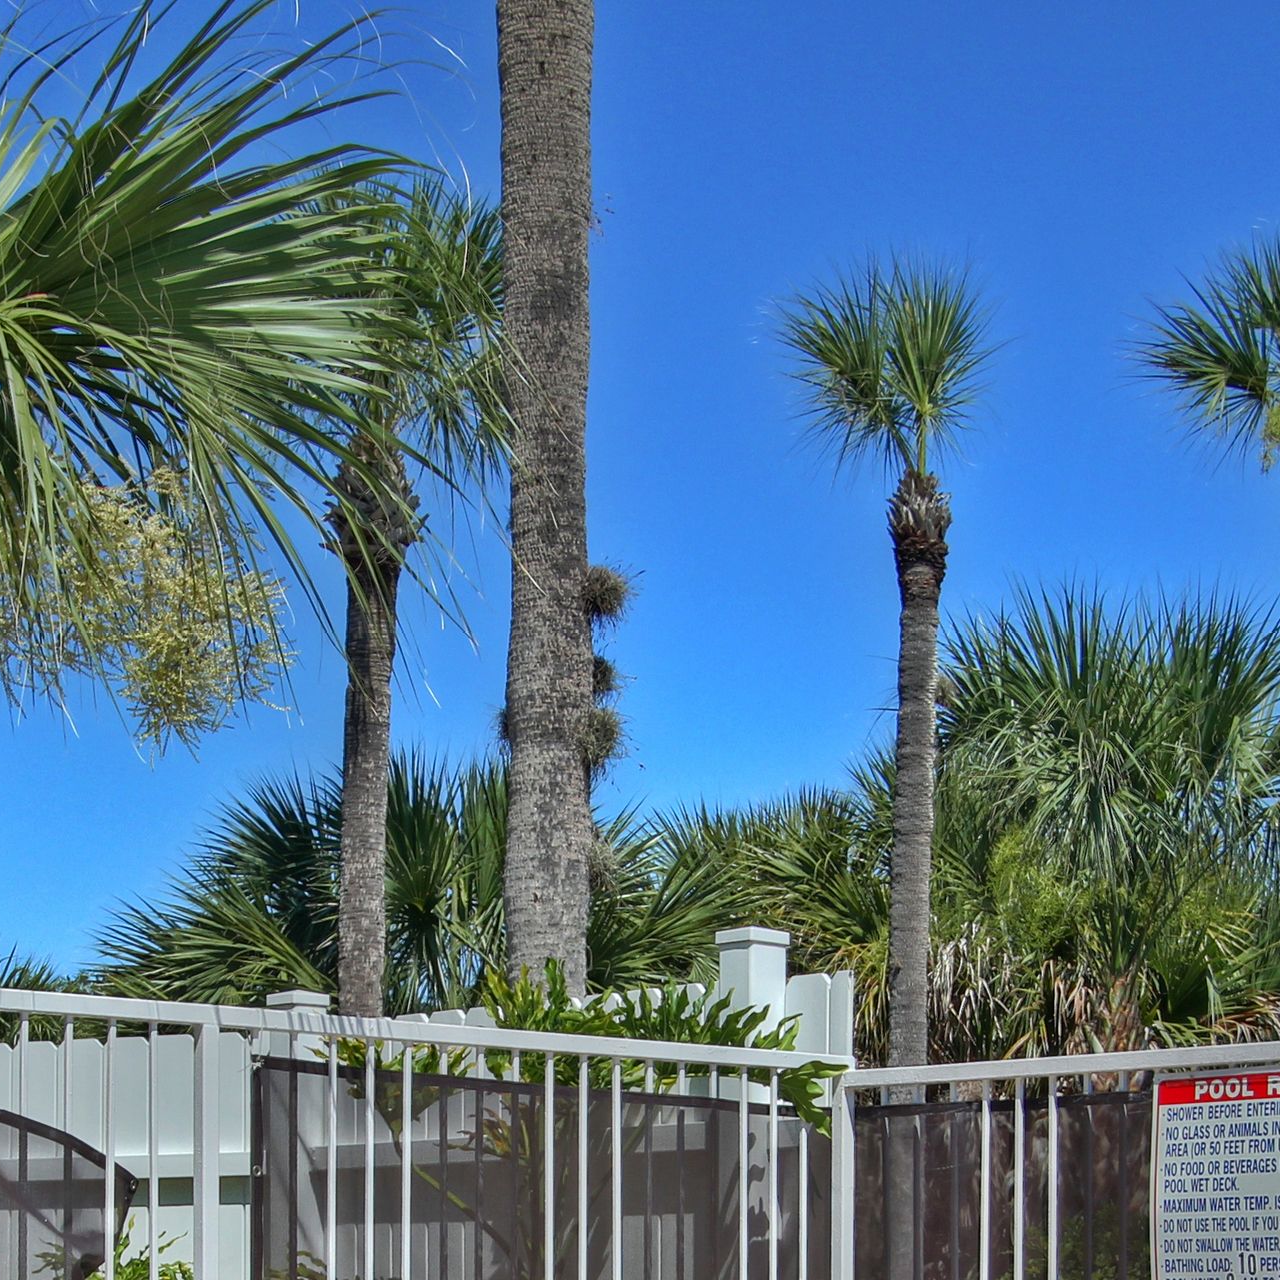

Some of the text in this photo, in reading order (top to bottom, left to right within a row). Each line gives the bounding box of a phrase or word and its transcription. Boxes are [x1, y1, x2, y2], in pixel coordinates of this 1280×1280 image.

[1194, 1078, 1254, 1100] POOL
[1167, 1107, 1203, 1122] SHOWER
[1209, 1103, 1242, 1119] BEFORE
[1166, 1127, 1179, 1140] NO
[1183, 1125, 1210, 1140] GLASS
[1213, 1123, 1224, 1138] OR
[1228, 1120, 1268, 1137] ANIMALS
[1272, 1121, 1280, 1135] IN
[1165, 1143, 1188, 1157] AREA
[1191, 1142, 1206, 1159] (OR
[1210, 1143, 1220, 1155] 50
[1223, 1140, 1245, 1155] FEET
[1249, 1138, 1275, 1153] FROM
[1164, 1162, 1177, 1177] NO
[1180, 1161, 1204, 1176] FOOD
[1208, 1161, 1220, 1175] OR
[1224, 1158, 1277, 1174] BEVERAGES
[1164, 1177, 1239, 1193] POOL WET DECK.
[1164, 1198, 1206, 1213] MAXIMUM
[1209, 1197, 1241, 1211] WATER
[1244, 1195, 1272, 1210] TEMP.
[1164, 1219, 1175, 1233] DO
[1177, 1219, 1193, 1233] NOT
[1194, 1218, 1209, 1232] USE
[1212, 1217, 1227, 1232] THE
[1229, 1216, 1250, 1231] POOL
[1252, 1216, 1259, 1231] IF
[1261, 1216, 1279, 1230] YOU
[1164, 1239, 1174, 1252] DO
[1177, 1238, 1193, 1252] NOT
[1195, 1237, 1233, 1252] SWALLOW
[1235, 1237, 1250, 1251] THE
[1165, 1259, 1203, 1273] BATHING
[1207, 1257, 1233, 1272] LOAD:
[1238, 1252, 1257, 1275] 10
